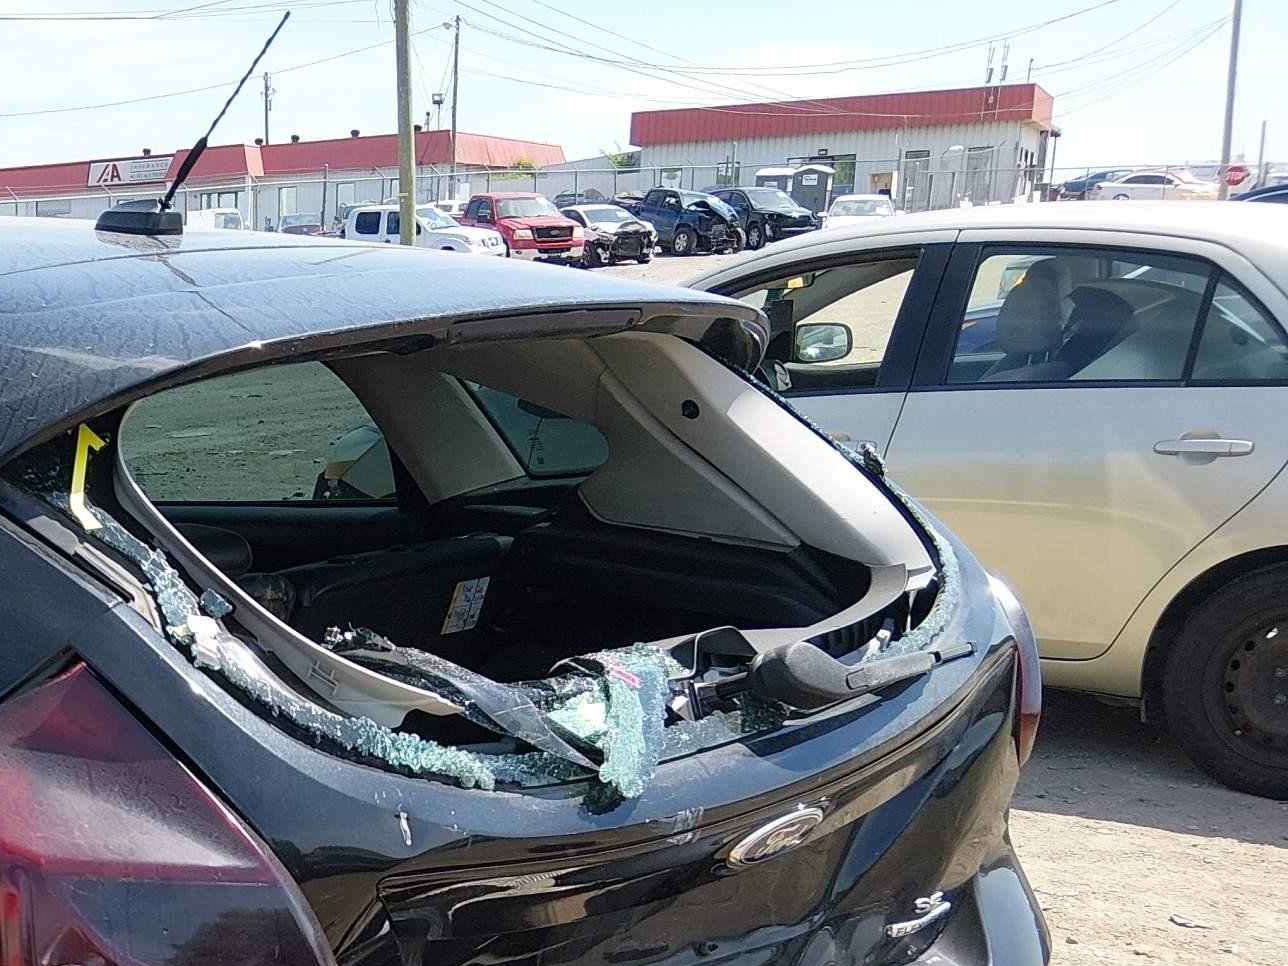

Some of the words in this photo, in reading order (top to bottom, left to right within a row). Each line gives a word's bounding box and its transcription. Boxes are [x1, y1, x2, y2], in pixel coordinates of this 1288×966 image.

[1224, 171, 1245, 181] STOP
[752, 823, 808, 859] Ford
[914, 891, 945, 914] SE
